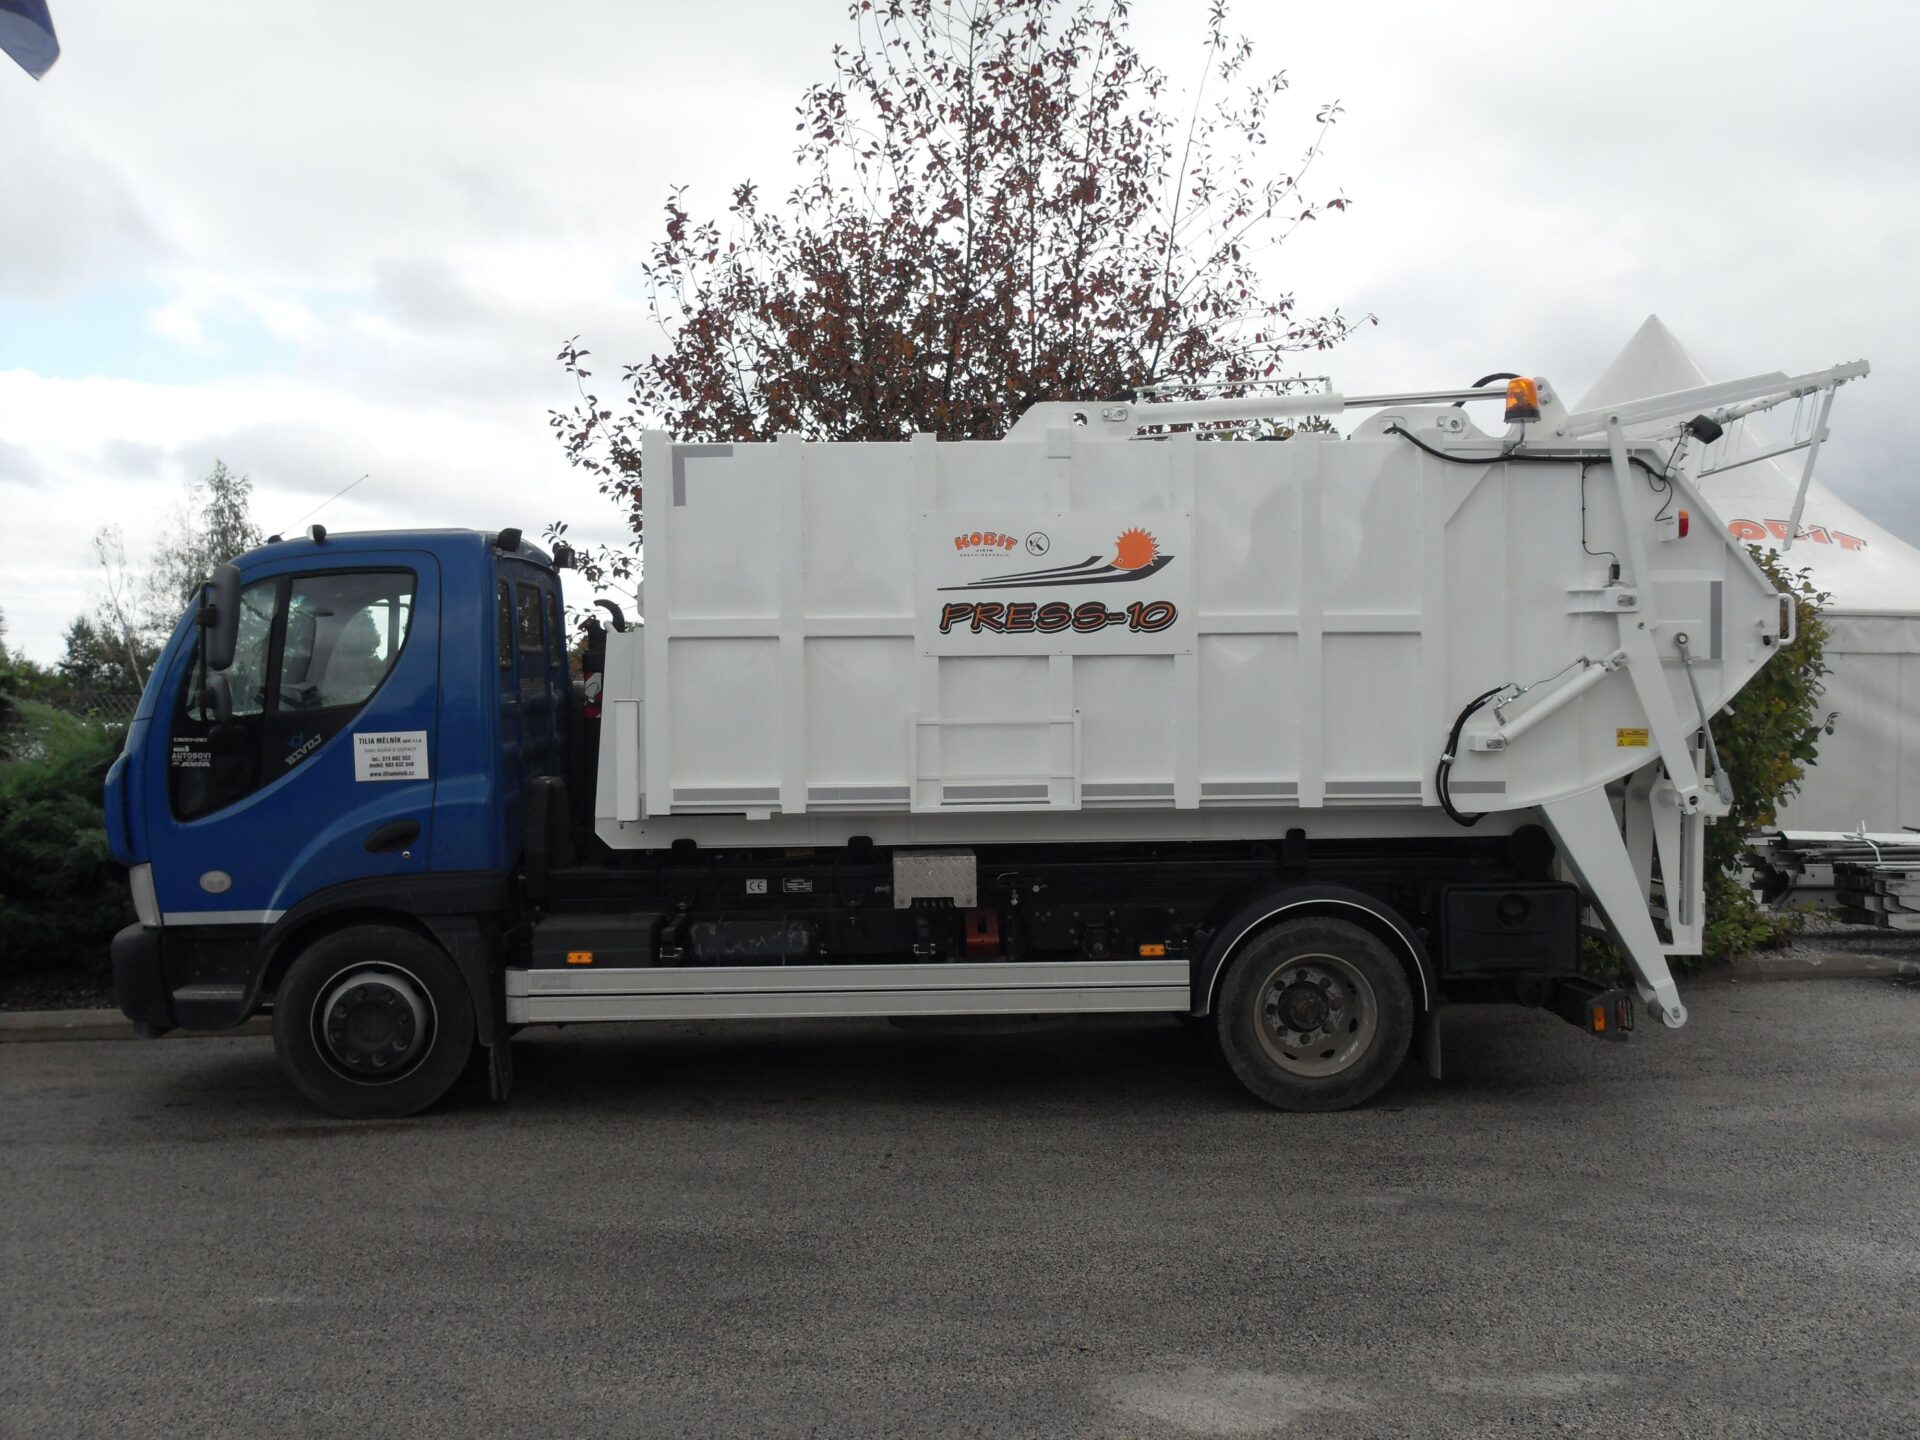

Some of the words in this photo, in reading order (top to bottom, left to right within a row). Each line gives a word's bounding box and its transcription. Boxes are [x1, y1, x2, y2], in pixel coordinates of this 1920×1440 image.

[954, 531, 1018, 551] KOBIT
[1727, 518, 1868, 551] OBIT
[939, 600, 1179, 634] PRESS-10
[358, 737, 375, 745] TILIA
[749, 881, 762, 891] CE
